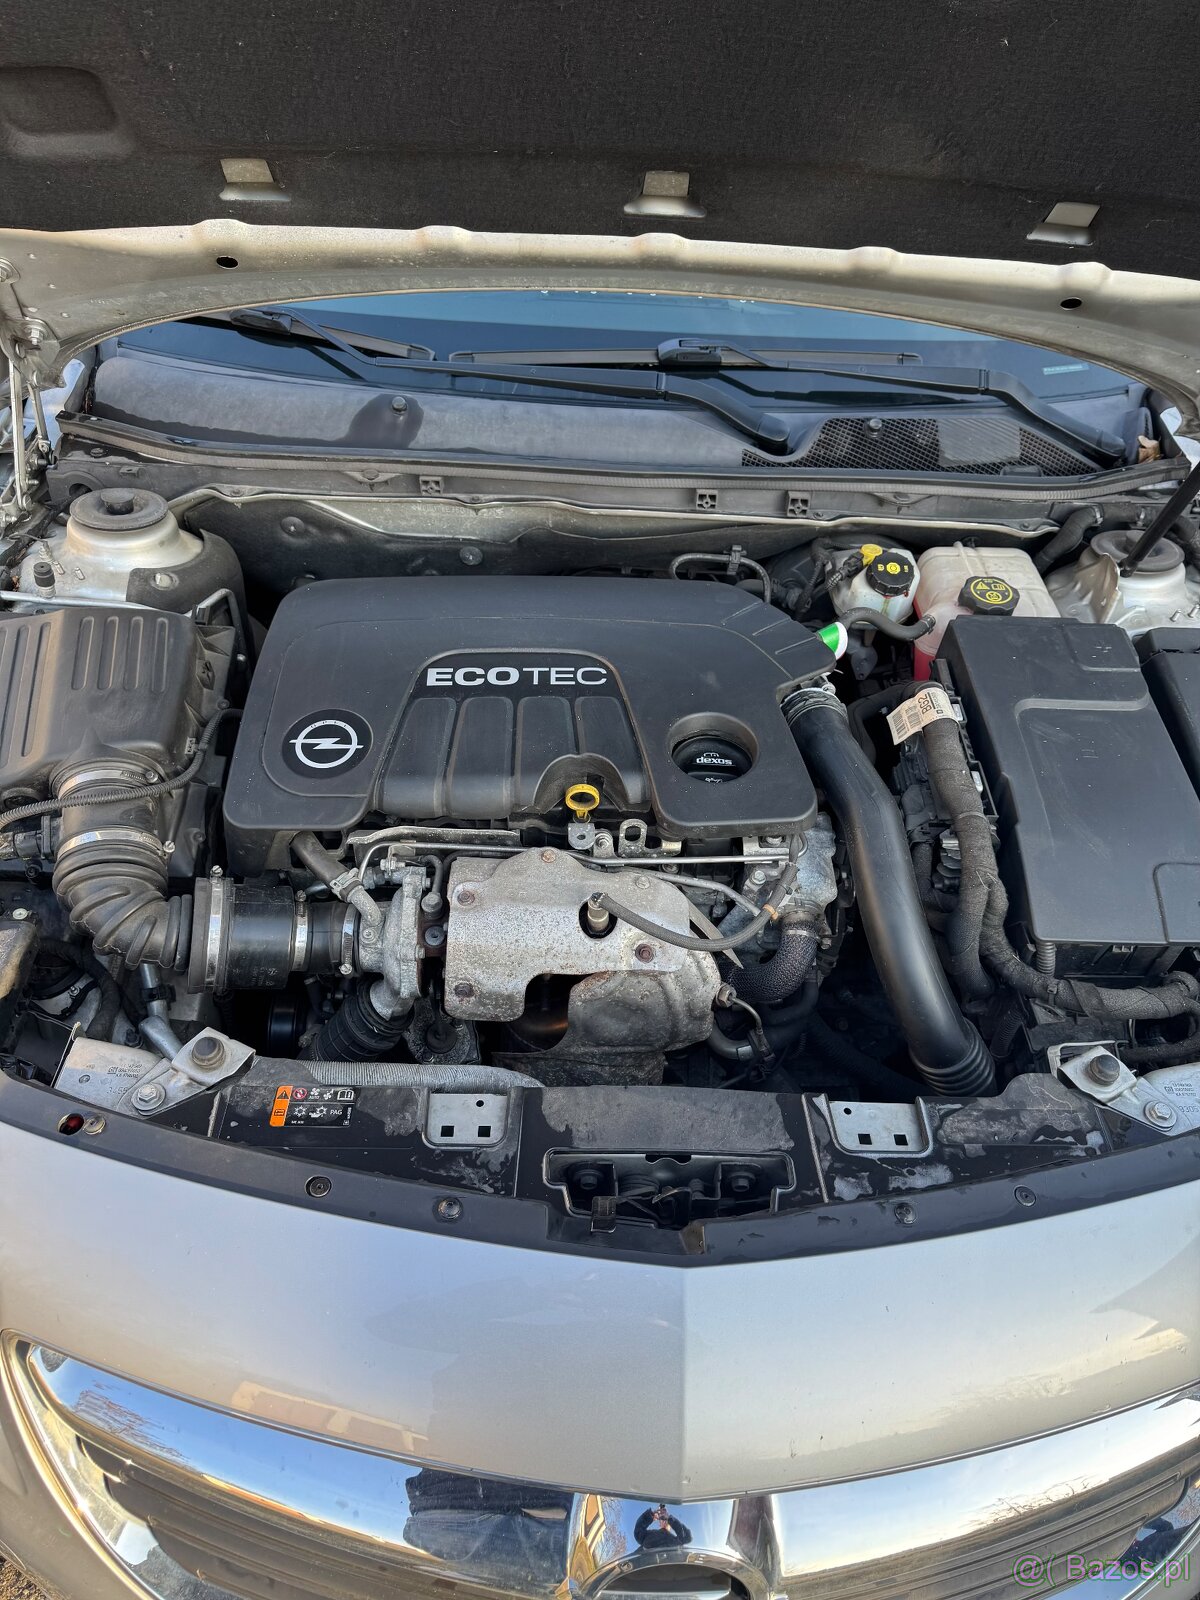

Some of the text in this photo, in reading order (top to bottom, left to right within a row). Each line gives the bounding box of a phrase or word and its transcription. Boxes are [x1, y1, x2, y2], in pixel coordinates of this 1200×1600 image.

[426, 666, 607, 686] ECOTEC
[696, 756, 733, 765] dexos
[329, 1108, 343, 1116] PAG
